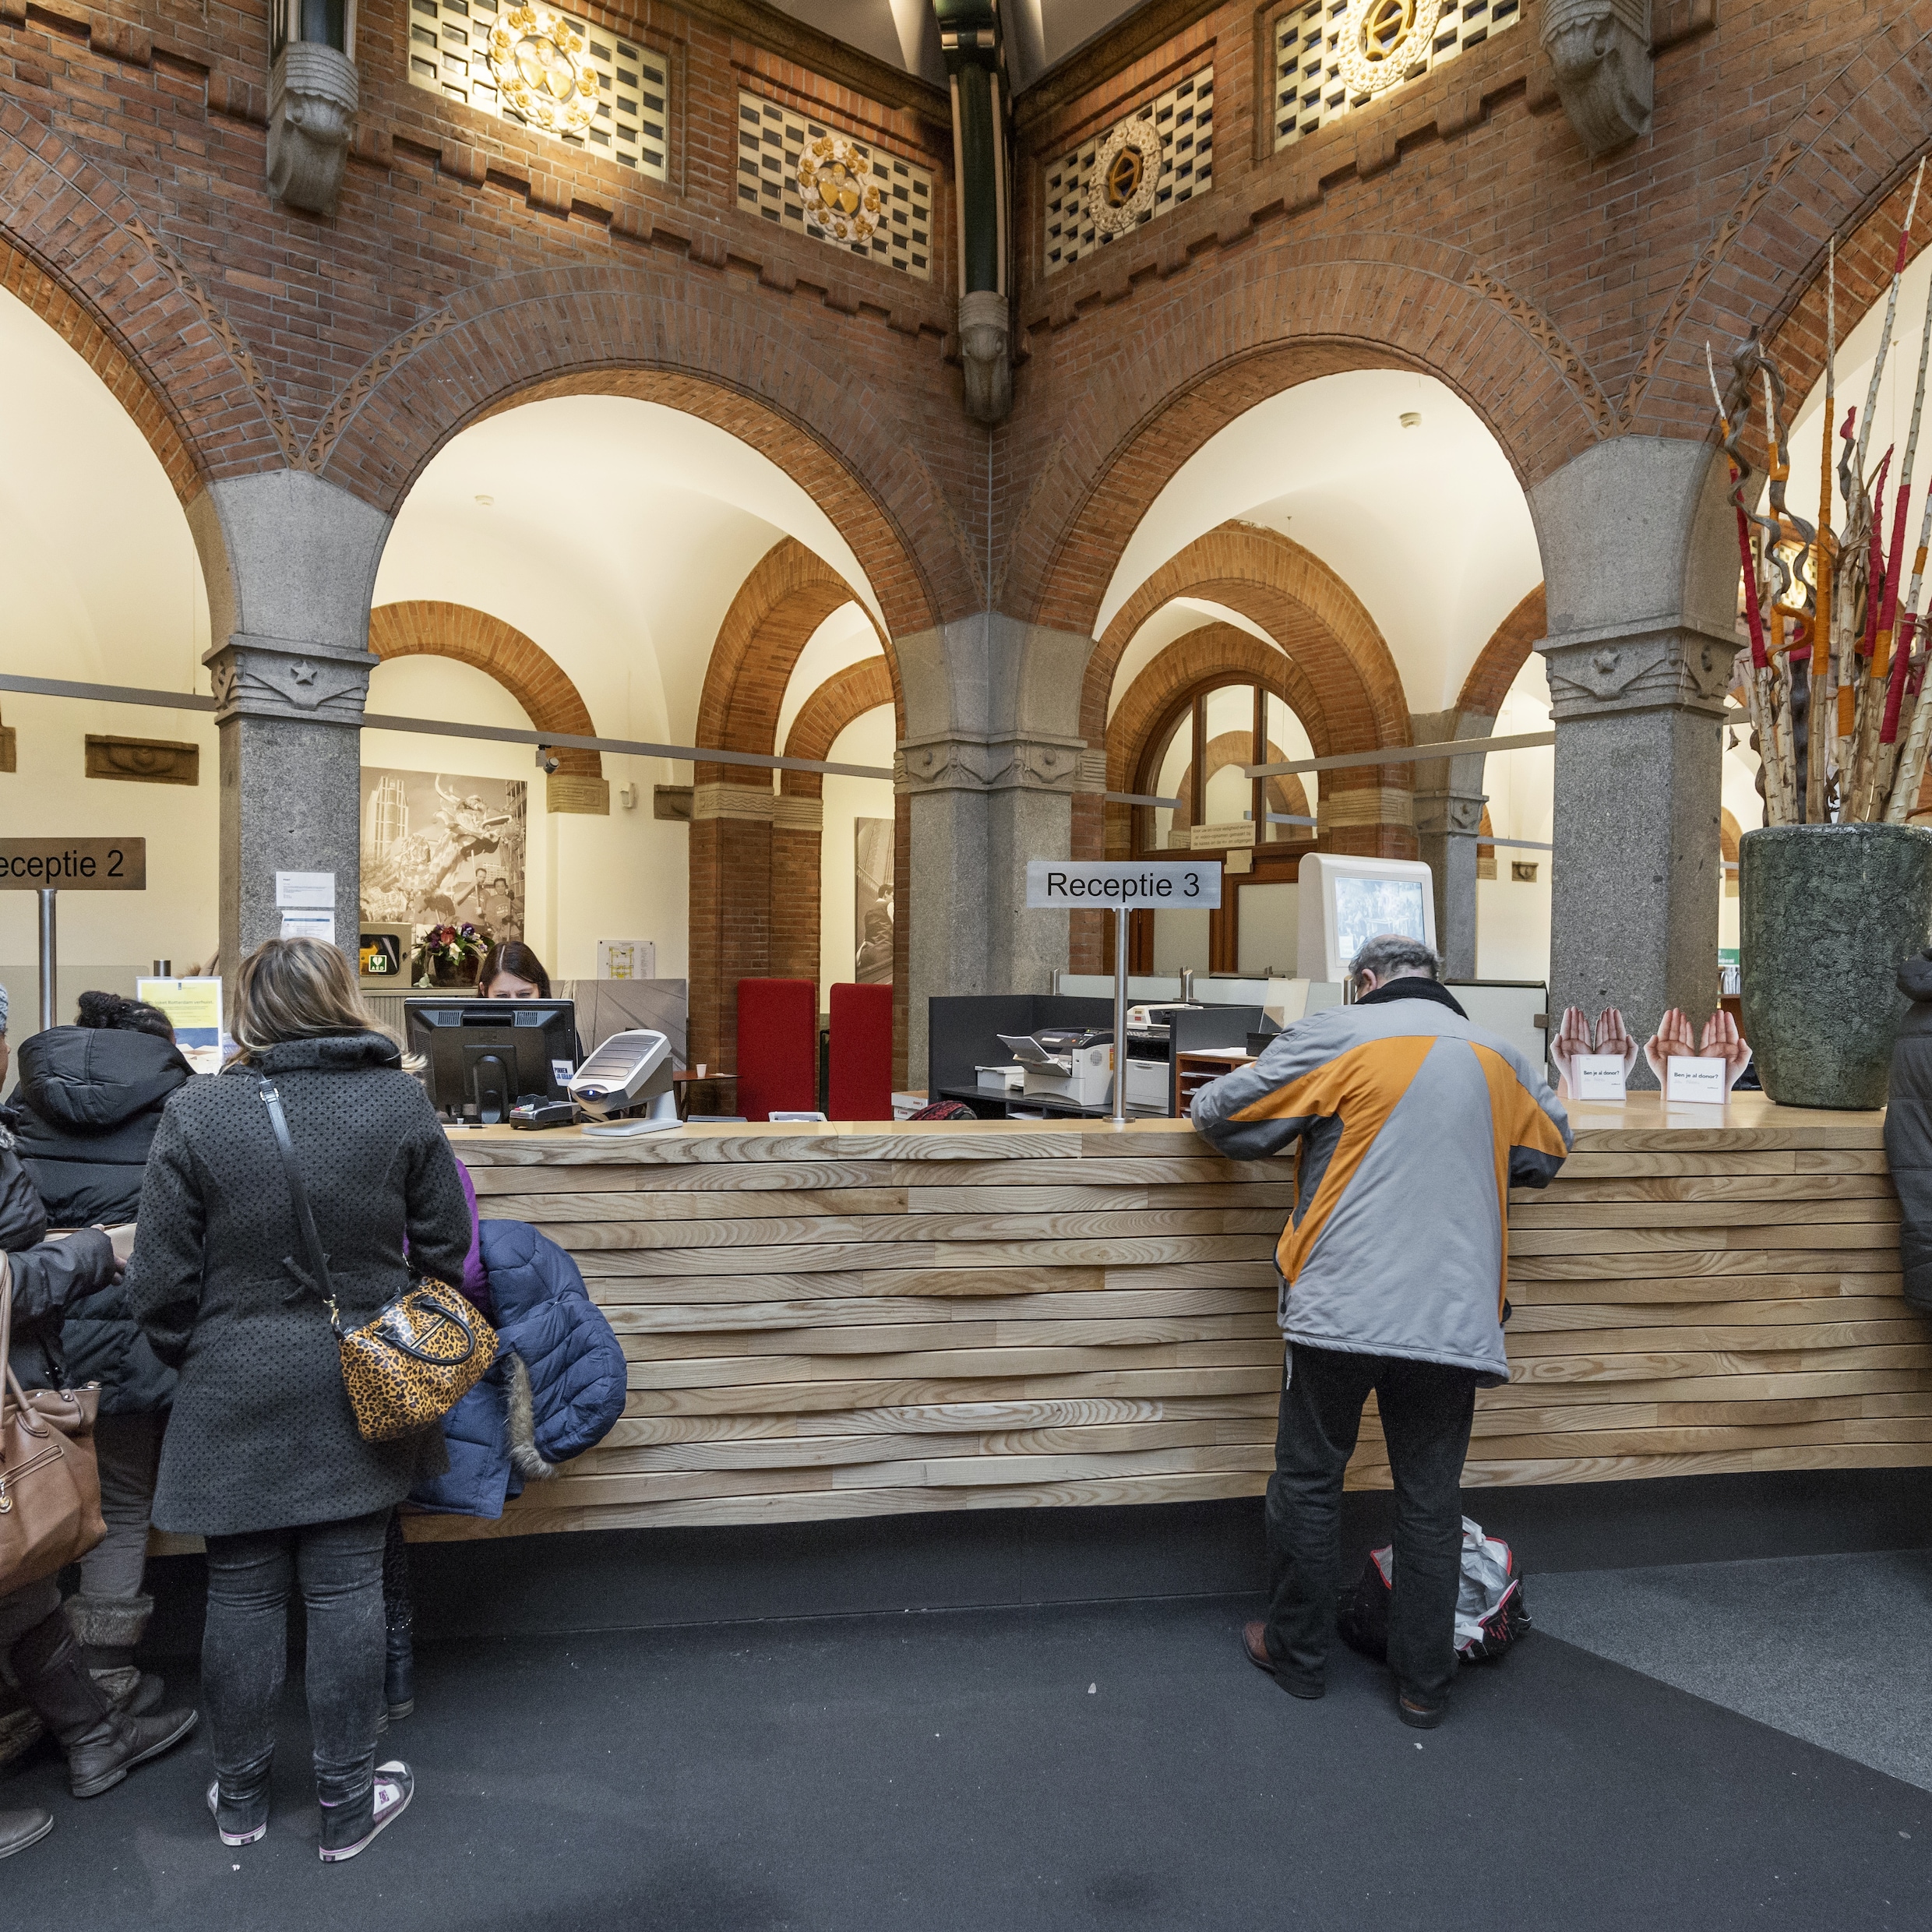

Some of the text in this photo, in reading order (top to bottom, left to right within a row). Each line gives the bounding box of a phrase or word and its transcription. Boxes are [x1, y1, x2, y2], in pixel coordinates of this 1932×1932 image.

[108, 850, 124, 876] 2
[1047, 873, 1200, 902] Receptie 3
